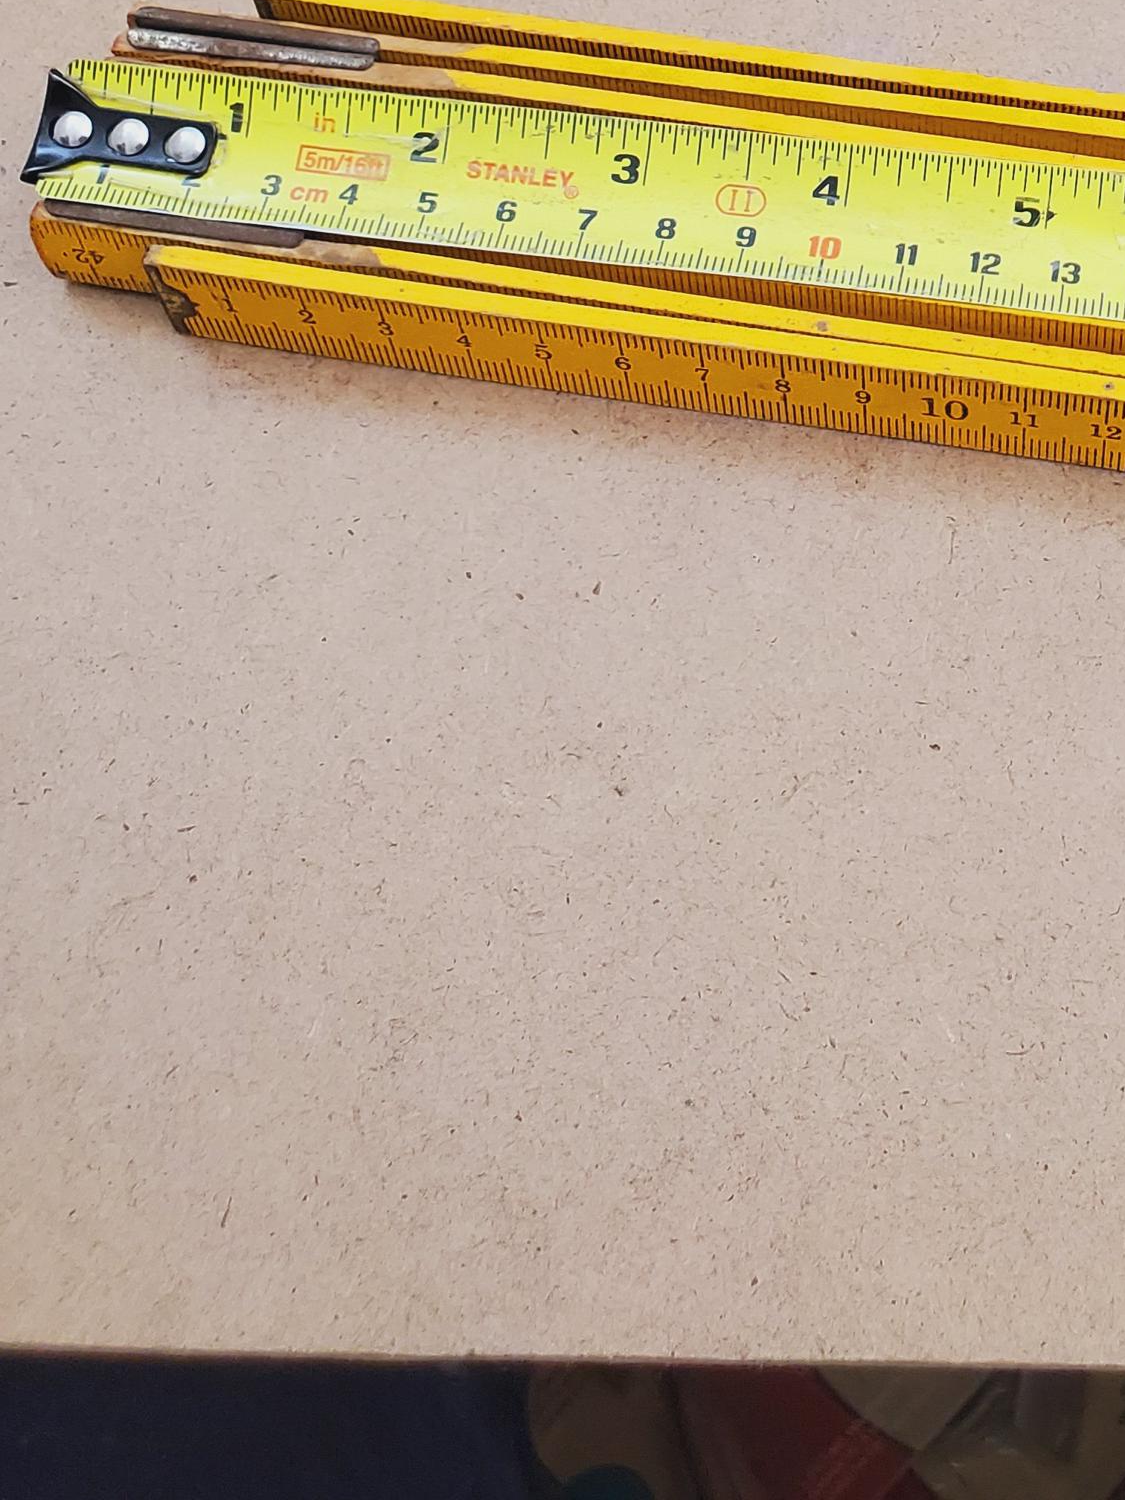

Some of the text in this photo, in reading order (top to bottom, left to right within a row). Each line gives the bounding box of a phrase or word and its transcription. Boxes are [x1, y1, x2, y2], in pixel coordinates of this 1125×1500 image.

[229, 102, 245, 133] 1
[410, 131, 440, 163] 2
[610, 153, 641, 185] 3
[812, 175, 840, 206] 4
[1012, 196, 1041, 228] 5
[313, 112, 336, 133] in
[260, 174, 282, 196] 3
[338, 183, 359, 205] 4
[417, 192, 439, 213] 5
[495, 201, 517, 223] 6
[578, 208, 598, 231] 7
[655, 218, 677, 240] 8
[735, 226, 757, 248] 9
[808, 235, 842, 260] 10
[895, 243, 918, 266] 11
[970, 251, 1001, 275] 12
[1050, 260, 1081, 285] 13
[290, 186, 329, 203] cm
[222, 298, 238, 313] 1
[298, 310, 317, 325] 2
[378, 321, 394, 336] 3
[456, 335, 472, 348] 4
[535, 344, 552, 360] 5
[614, 357, 632, 371] 6
[694, 368, 710, 381] 7
[775, 379, 791, 393] 8
[855, 390, 871, 404] 9
[921, 397, 969, 421] 10
[1010, 411, 1040, 428] 11
[1090, 424, 1122, 440] 12
